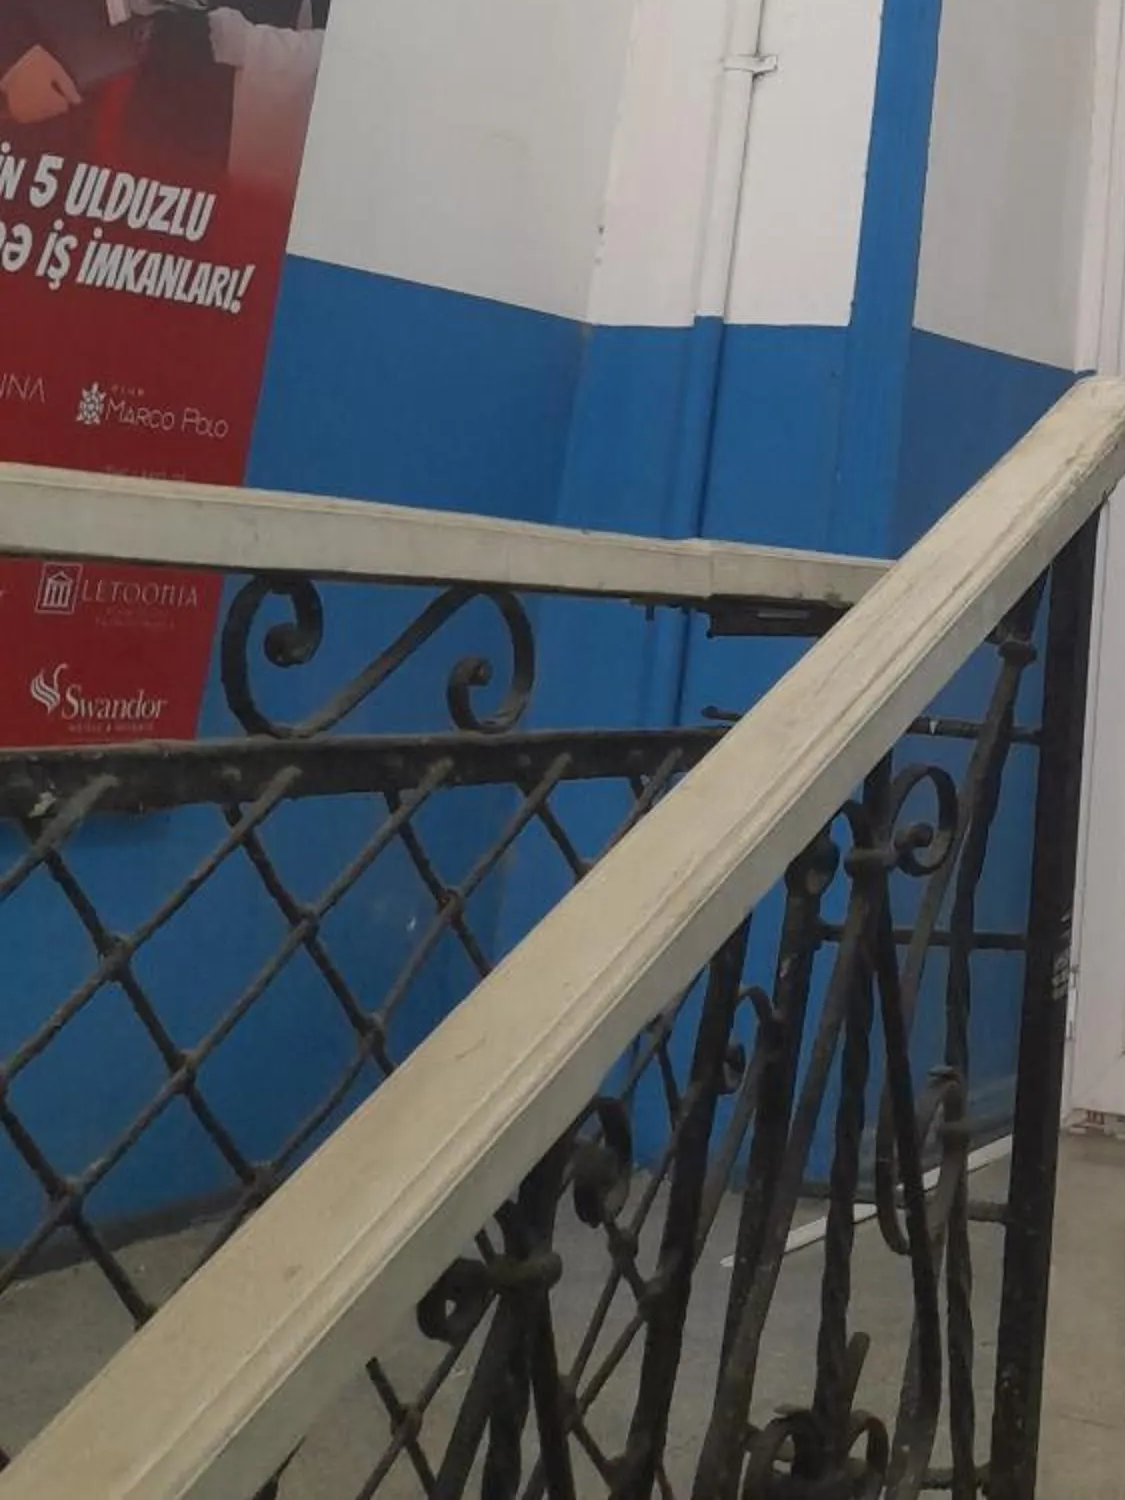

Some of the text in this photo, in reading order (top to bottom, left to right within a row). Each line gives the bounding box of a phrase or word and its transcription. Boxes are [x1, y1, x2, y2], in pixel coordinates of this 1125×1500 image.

[29, 154, 65, 208] 5
[65, 163, 217, 242] ULDUZLU
[36, 218, 78, 290] İŞ
[76, 226, 256, 314] İMKANLARI!
[105, 399, 229, 439] MARCO POLO
[61, 684, 167, 720] Swandor
